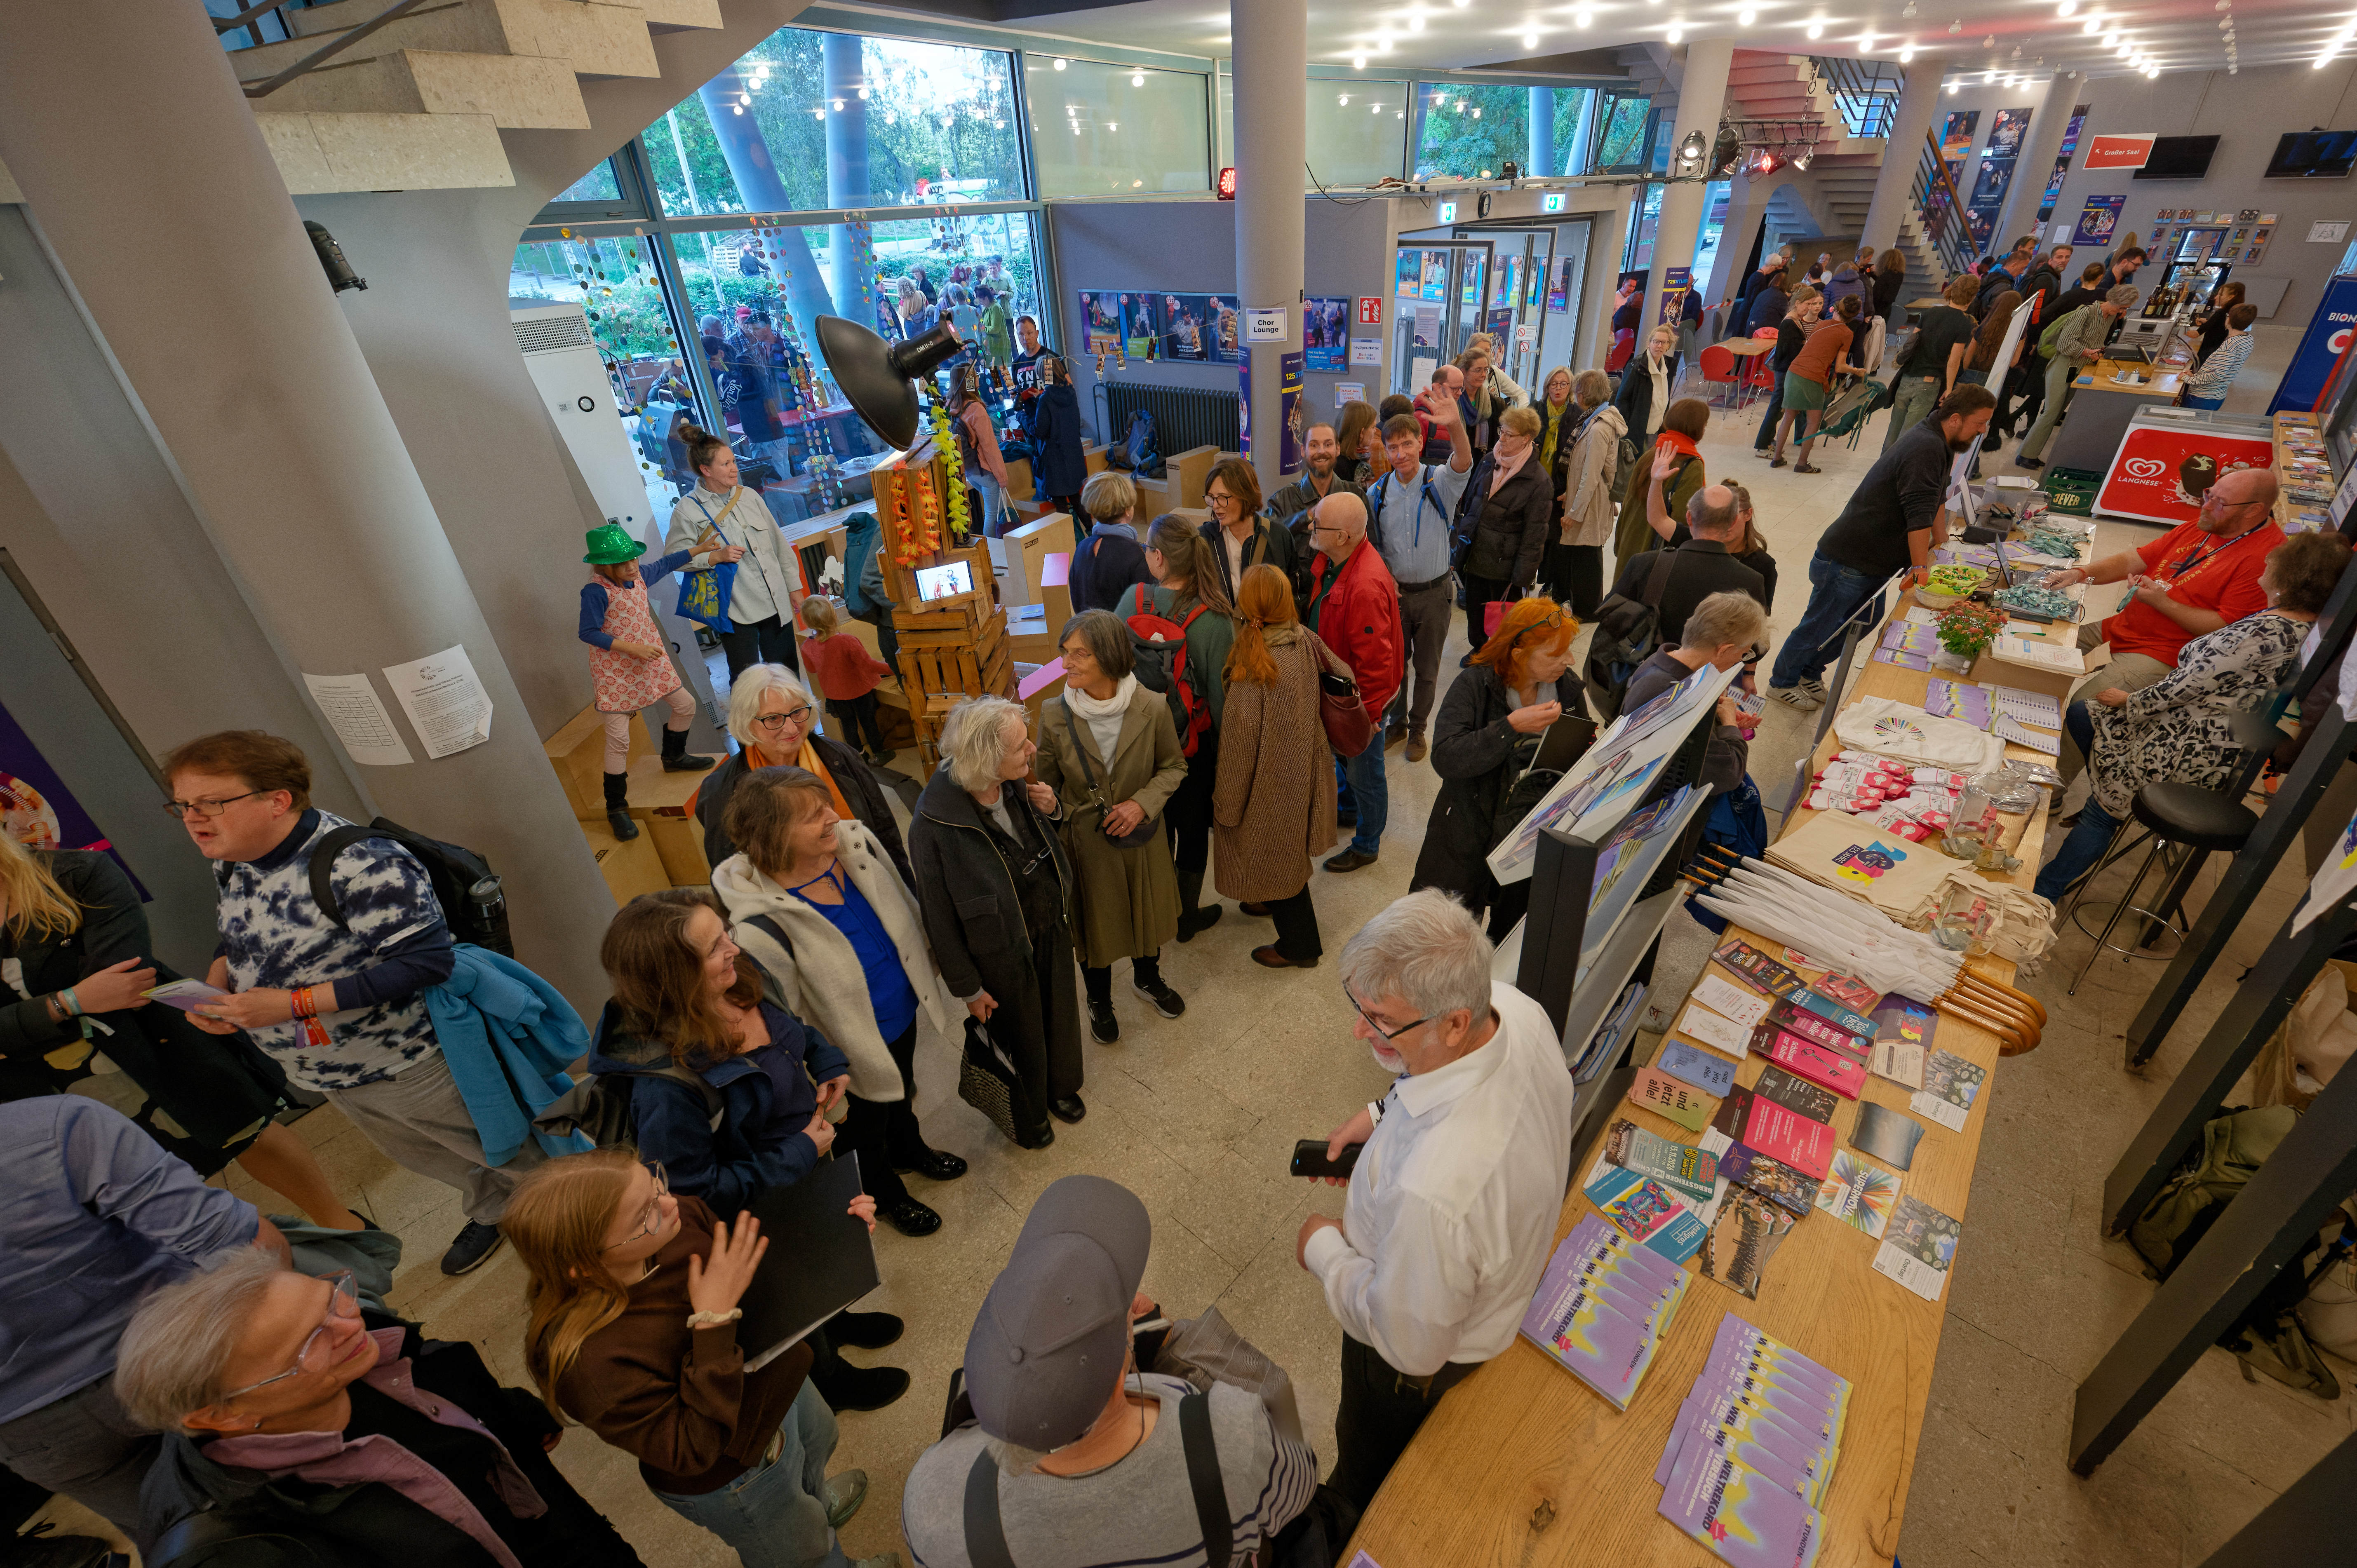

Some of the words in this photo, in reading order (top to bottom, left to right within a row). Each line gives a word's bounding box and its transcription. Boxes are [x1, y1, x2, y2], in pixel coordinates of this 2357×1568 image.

[2328, 312, 2357, 323] BION
[2117, 476, 2159, 486] LANGNESE
[2053, 493, 2080, 506] JEVER
[2176, 570, 2202, 586] besser
[1835, 851, 1852, 864] JAHRE
[1734, 952, 1746, 965] SING
[1819, 1028, 1830, 1039] eine
[1829, 1032, 1843, 1046] Spiel
[1787, 1041, 1798, 1062] Schlüssel
[1712, 1071, 1721, 1084] jetzt
[1646, 1079, 1660, 1100] alle!
[1661, 1082, 1676, 1106] jetzt
[1676, 1091, 1688, 1111] und
[1931, 1101, 1942, 1117] Chortag!
[1631, 1161, 1651, 1172] CHOR
[1666, 1145, 1678, 1171] 15.11.2026
[1699, 1153, 1710, 1183] KONZERT
[1687, 1158, 1696, 1180] Dresden
[1666, 1174, 1713, 1194] BERGSTEIGER
[1844, 1170, 1868, 1217] SUPERNOVA
[1677, 1223, 1704, 1246] LesMigraS
[1897, 1258, 1911, 1280] Chortag!
[1553, 1288, 1579, 1322] VERSUCH
[1580, 1298, 1594, 1314] DER
[1552, 1293, 1586, 1343] WELTREKORD
[1622, 1338, 1648, 1383] 125STUNDENCHOR
[1700, 1453, 1724, 1502] VERSUCH
[1730, 1465, 1743, 1486] DER
[1702, 1459, 1733, 1531] WELTREKORD
[1685, 1498, 1696, 1516] BERLIN
[1792, 1514, 1814, 1568] 125STUNDENCH
